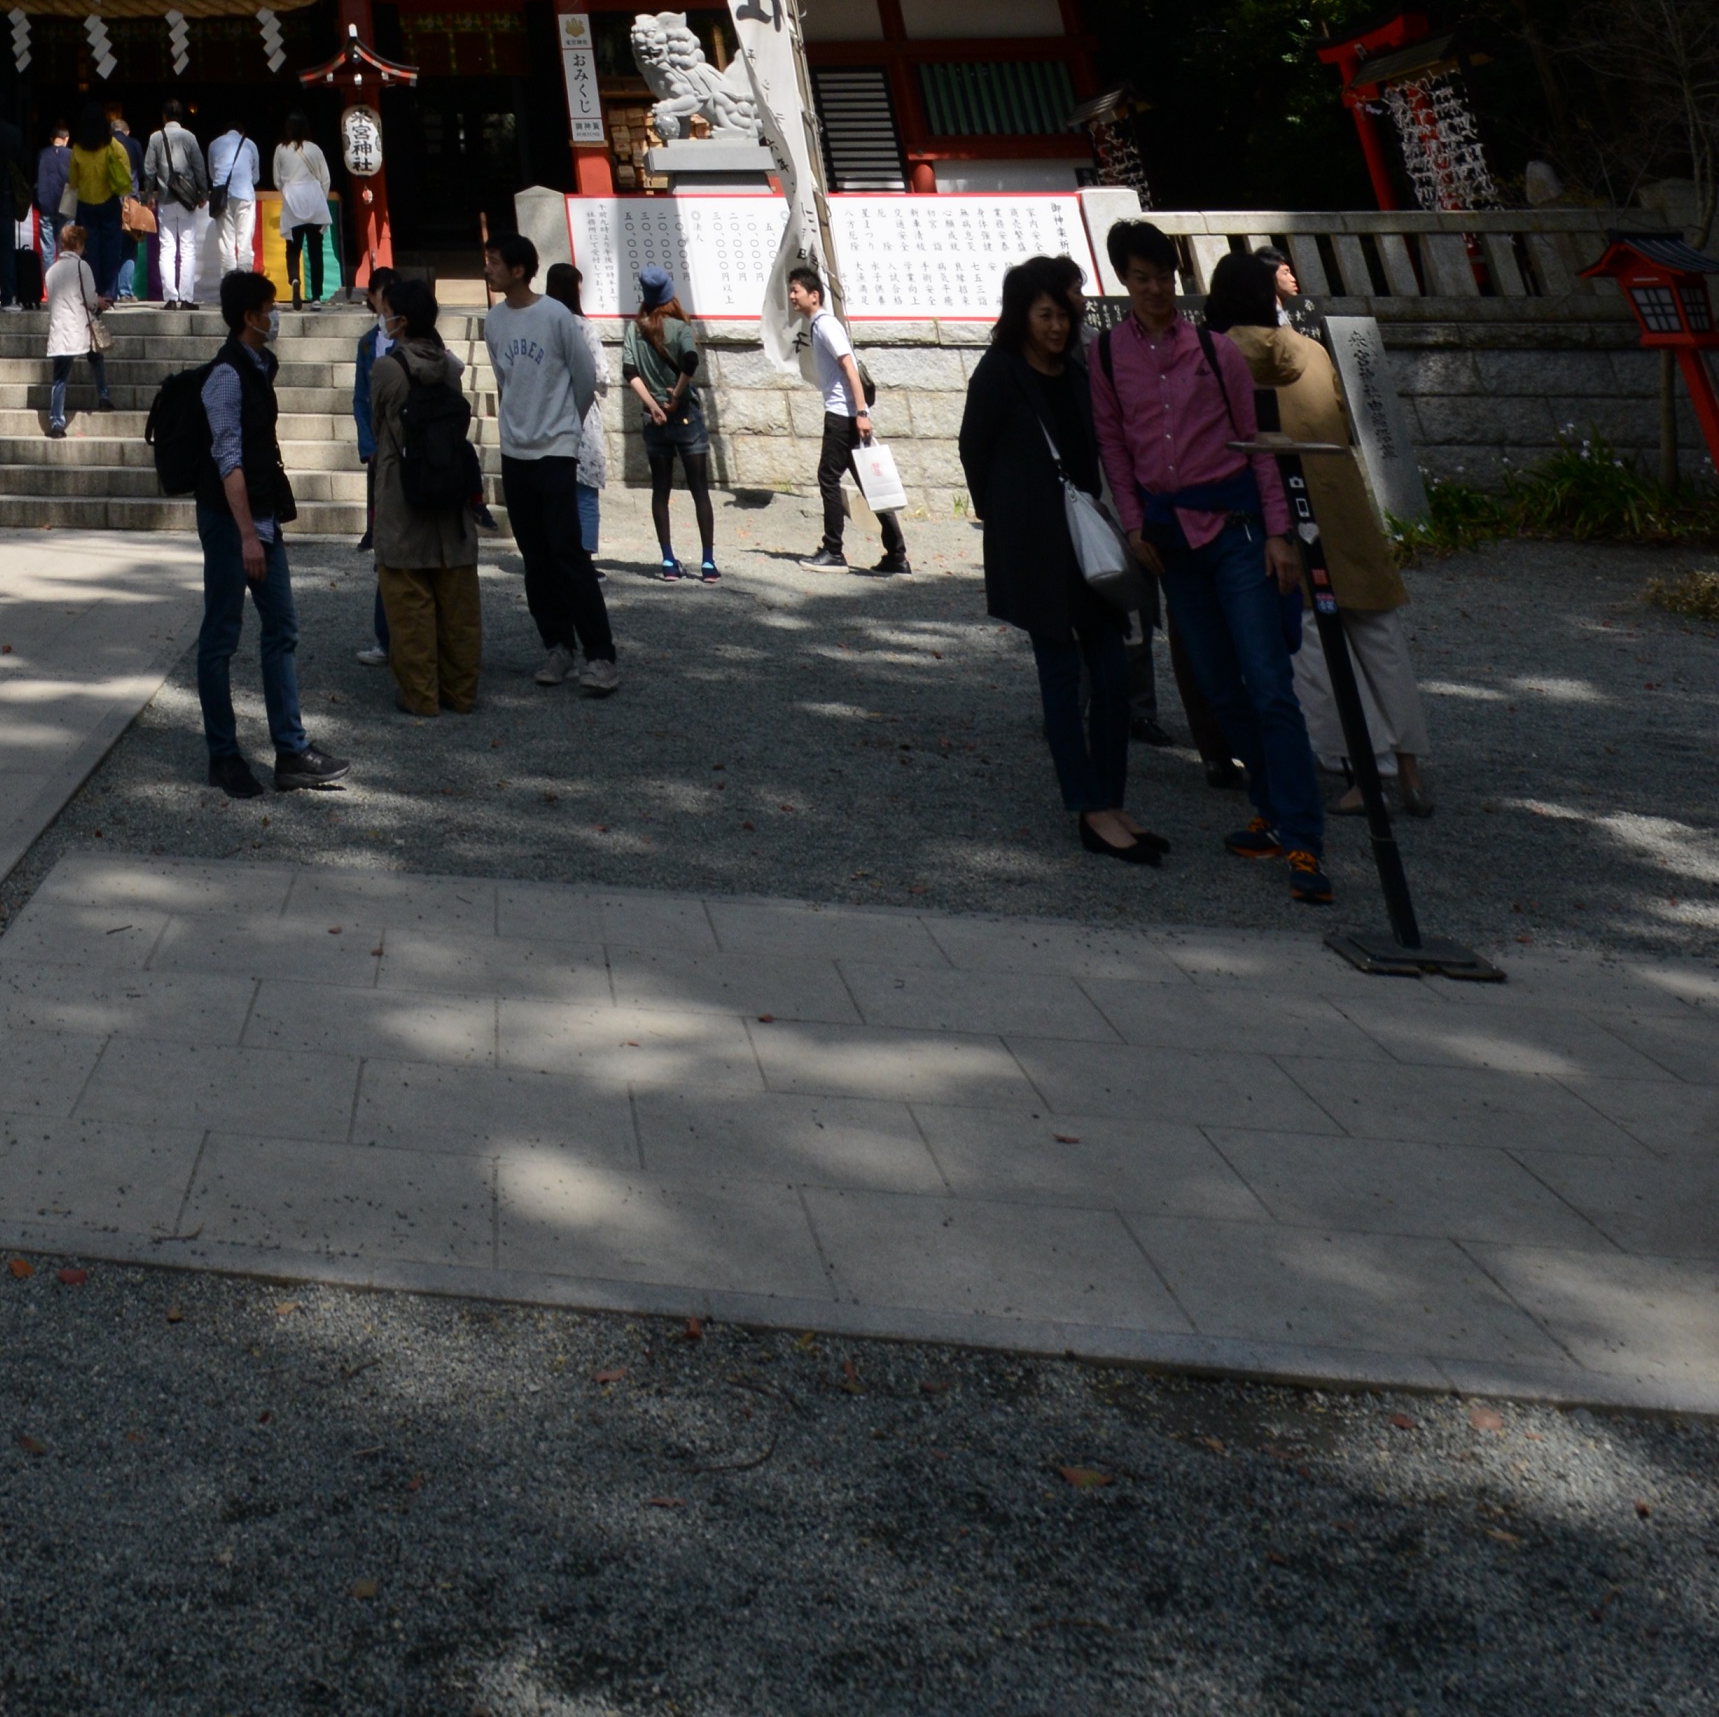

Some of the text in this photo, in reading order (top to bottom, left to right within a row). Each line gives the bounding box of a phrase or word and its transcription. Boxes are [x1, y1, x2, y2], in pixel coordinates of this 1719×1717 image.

[573, 54, 591, 113] おみくじ
[894, 208, 909, 251] 交通安全
[1027, 208, 1043, 252] 家内安全
